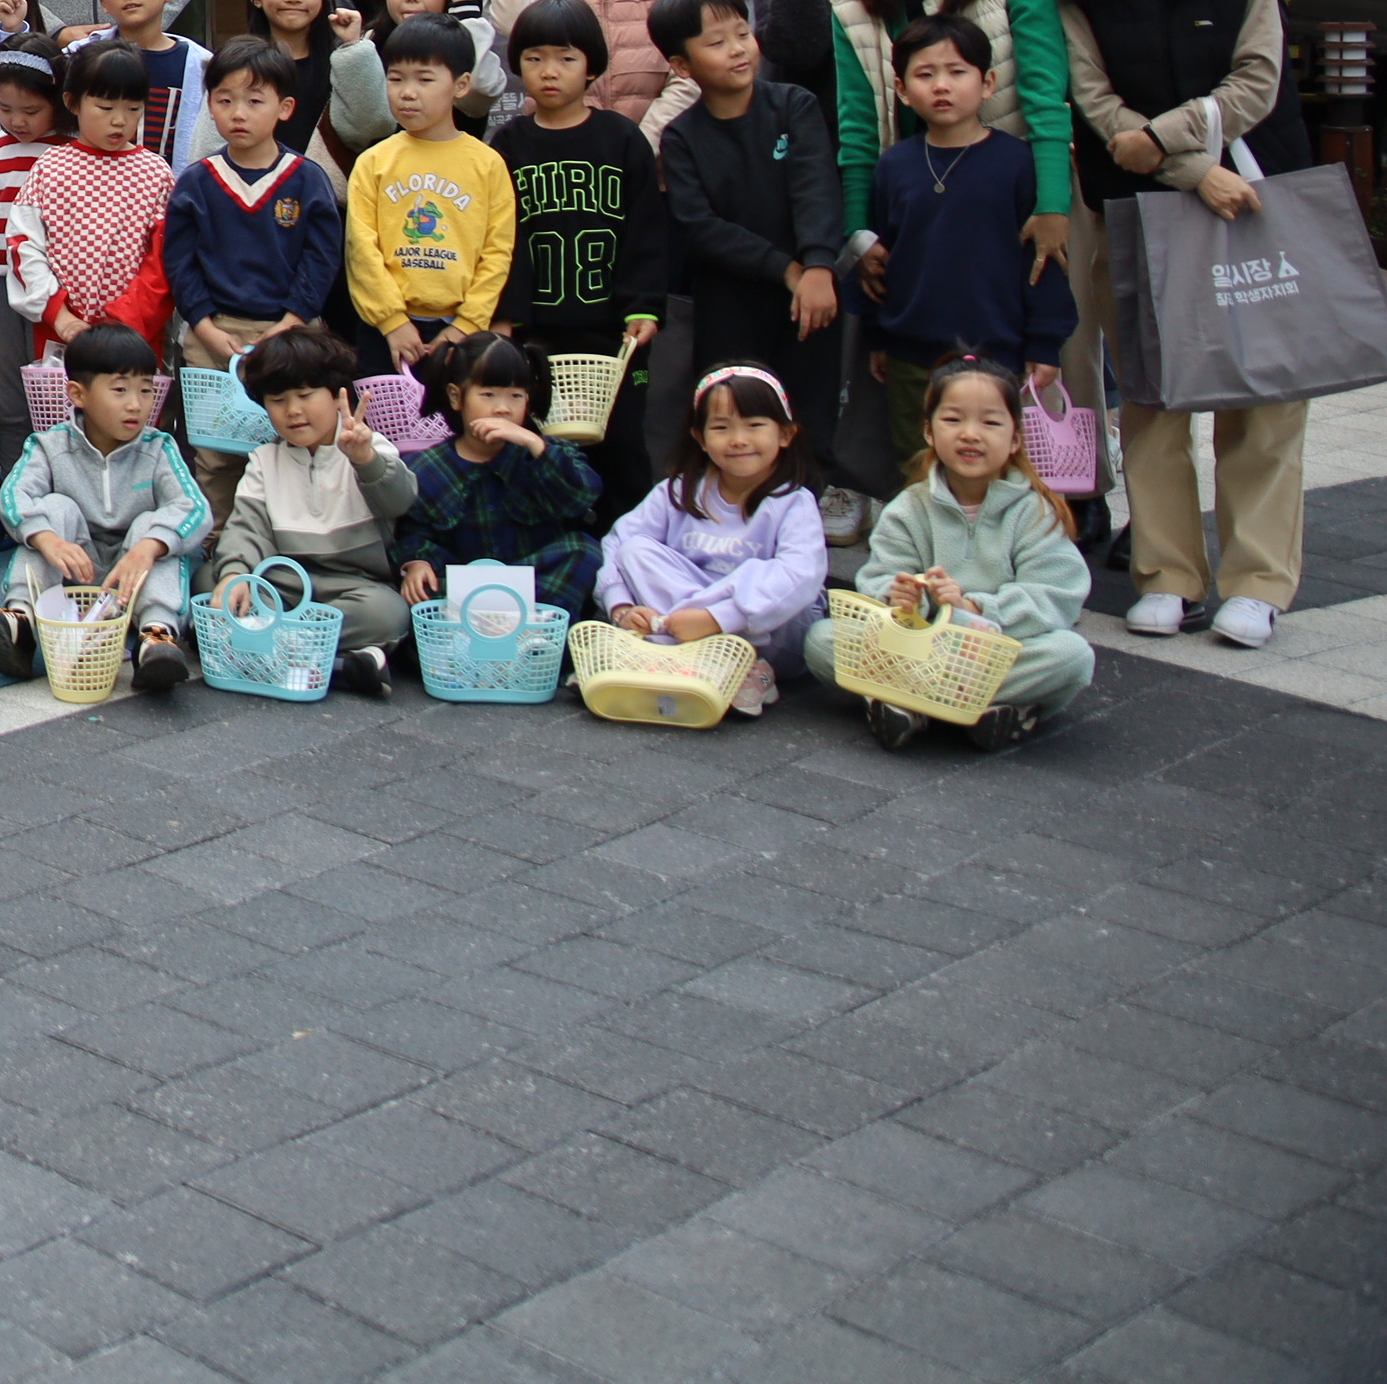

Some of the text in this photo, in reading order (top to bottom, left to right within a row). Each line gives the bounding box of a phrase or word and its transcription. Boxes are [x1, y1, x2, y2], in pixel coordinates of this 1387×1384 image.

[383, 172, 473, 213] FLORIDA
[401, 258, 446, 271] BASEBALL
[423, 248, 458, 262] LEAGUE
[528, 228, 618, 305] 08
[1234, 280, 1300, 304] 학생자치회
